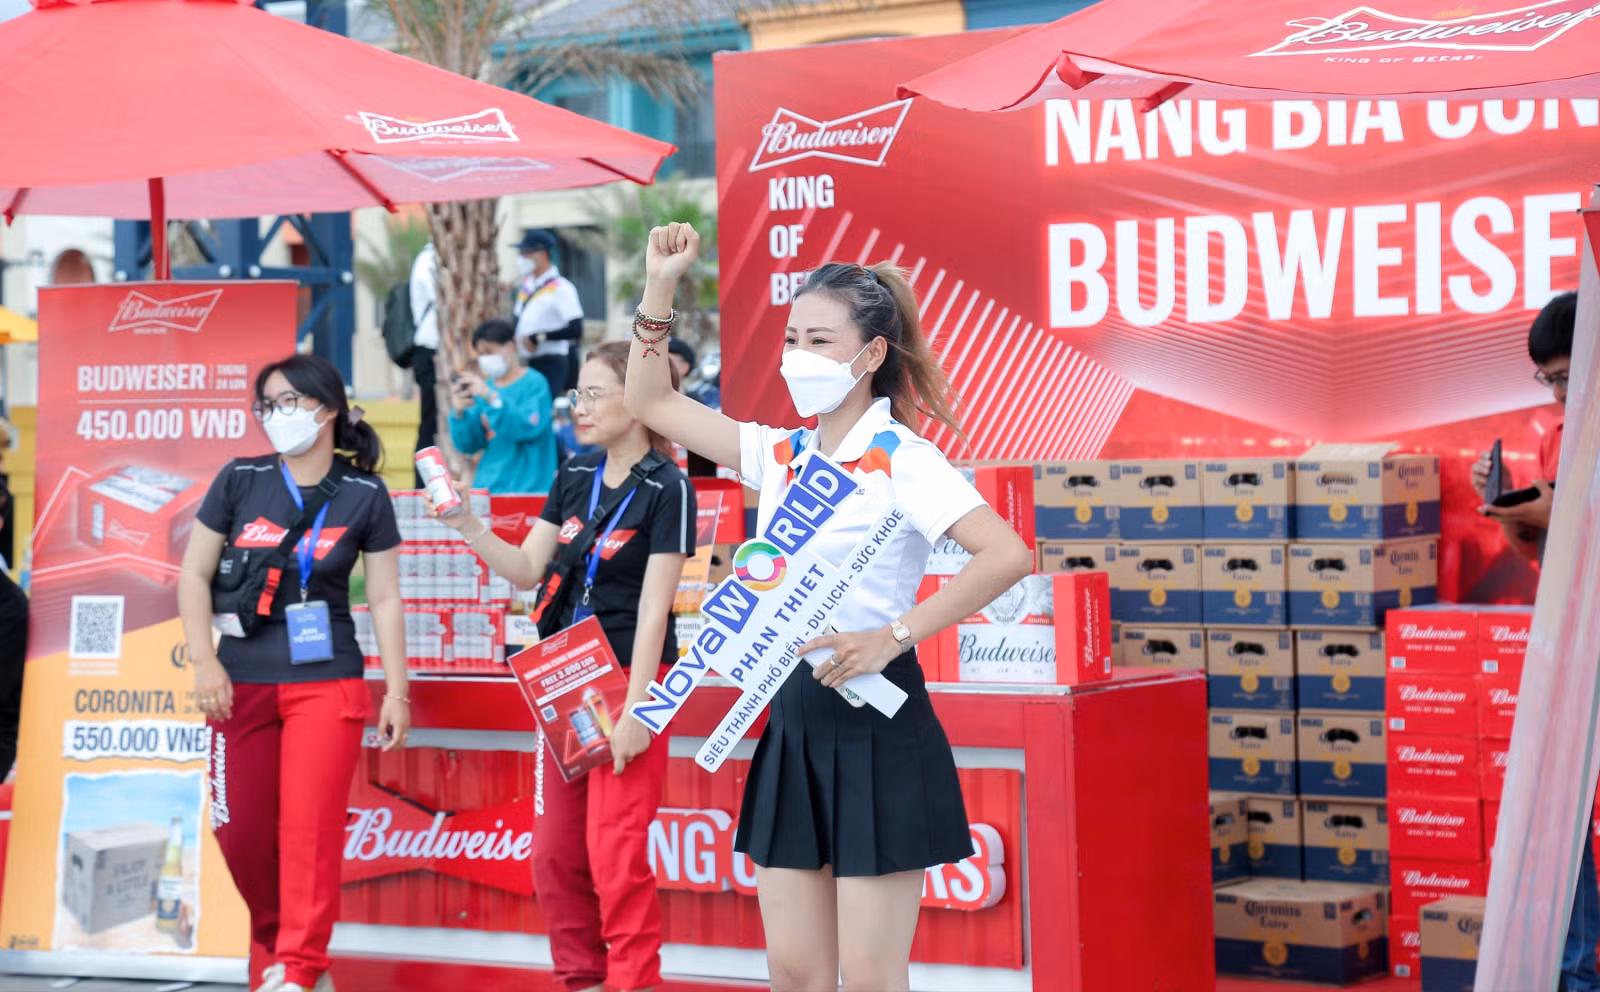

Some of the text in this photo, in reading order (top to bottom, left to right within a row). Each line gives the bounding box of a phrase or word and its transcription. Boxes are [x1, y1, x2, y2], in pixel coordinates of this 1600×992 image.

[354, 116, 514, 137] Budweiser
[762, 120, 896, 154] Budweiser
[768, 174, 835, 211] KING
[768, 224, 804, 259] OF
[1048, 191, 1583, 328] BUDWEISE
[770, 272, 813, 306] BE
[77, 363, 207, 392] BUDWEISER
[76, 408, 247, 441] 450.000 VNĐ
[730, 563, 825, 683] PHAN THIET
[1398, 623, 1467, 641] Budweiser
[703, 734, 730, 766] SIÊU
[725, 691, 763, 739] THÀNH
[757, 661, 784, 696] PHỐ
[808, 611, 827, 631] DU
[825, 580, 850, 612] LỊCH
[850, 543, 877, 574] SỨC
[75, 689, 175, 714] CORONITA
[1398, 684, 1467, 702] Budweiser
[73, 726, 159, 751] 550.000
[1396, 745, 1465, 764] Budweiser
[343, 806, 532, 860] Budweise
[1397, 807, 1466, 826] Budweiser
[648, 818, 717, 884] NG
[1402, 870, 1470, 889] Budweiser
